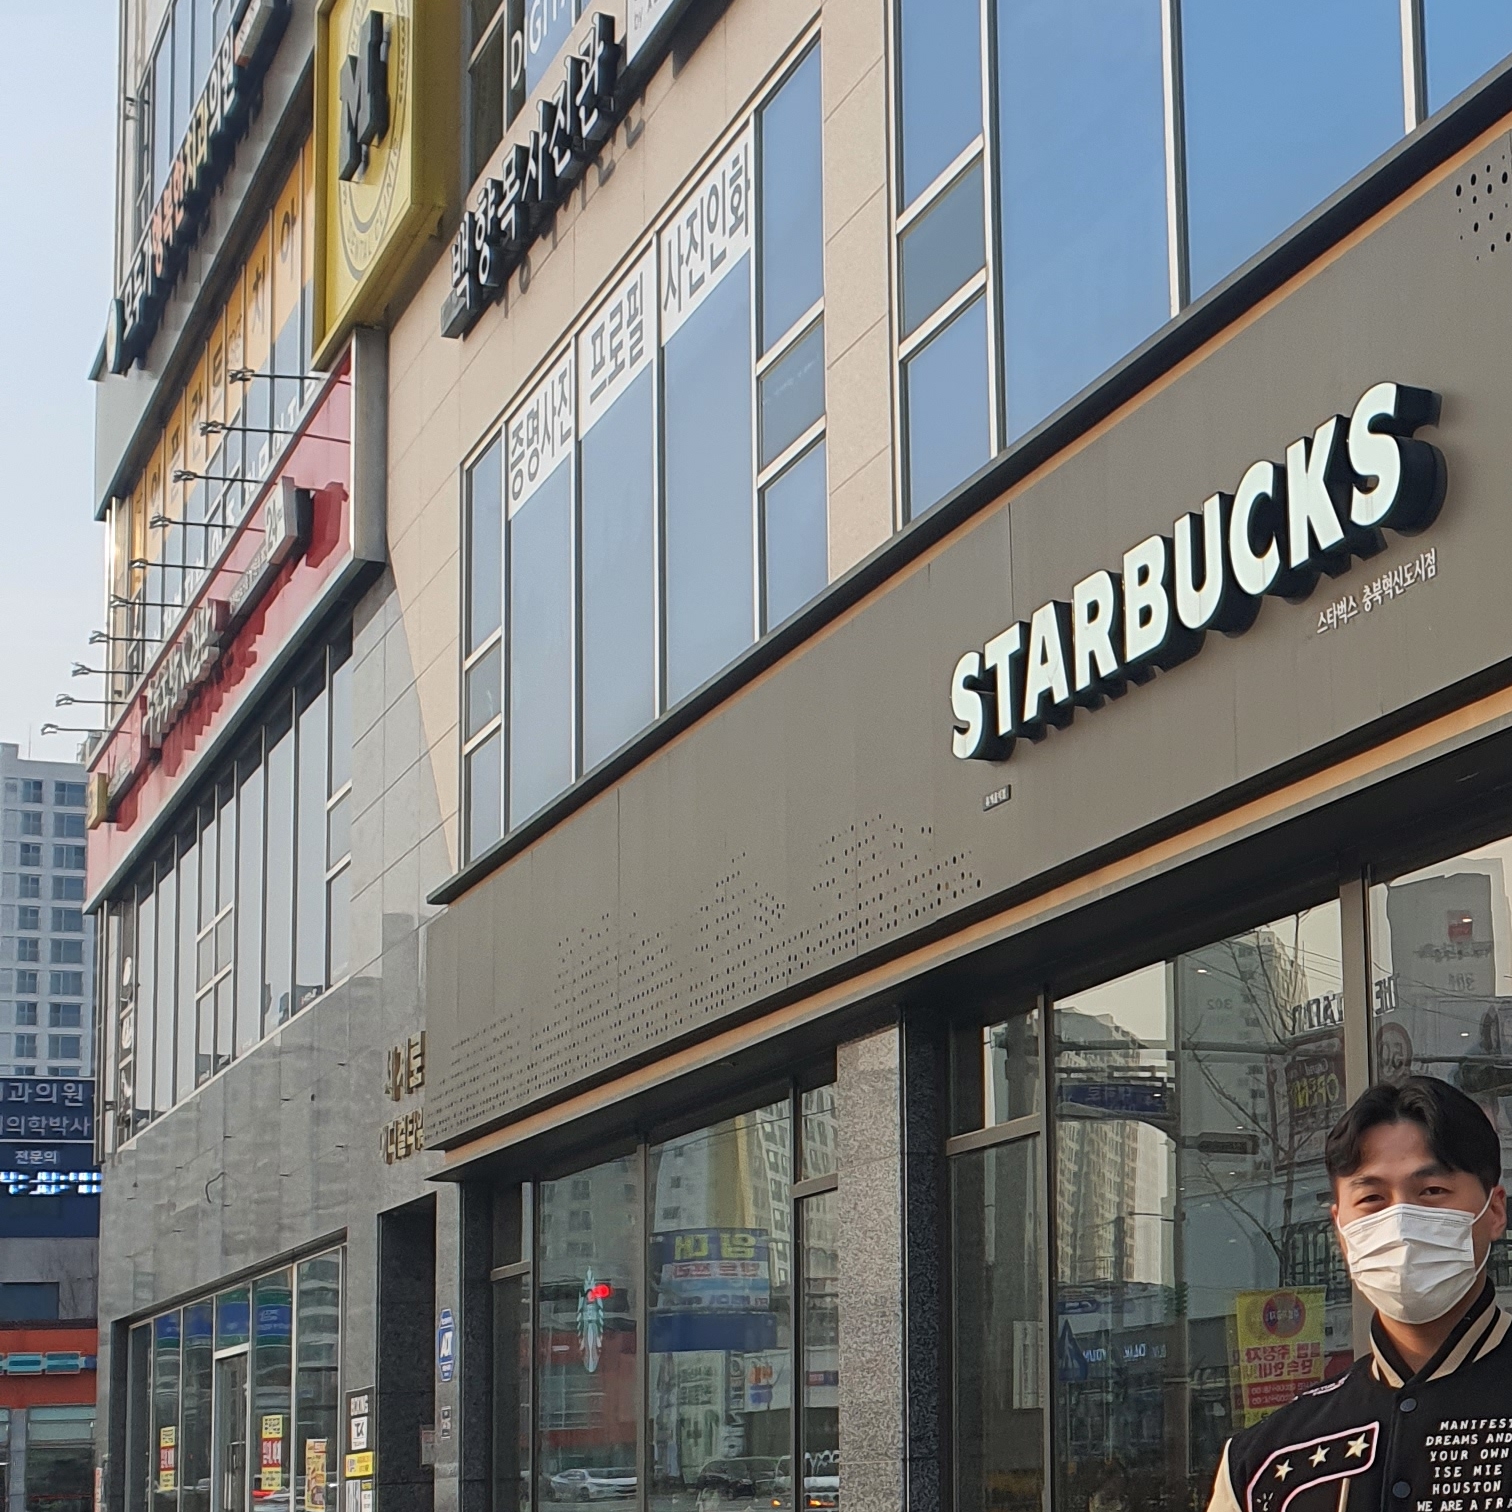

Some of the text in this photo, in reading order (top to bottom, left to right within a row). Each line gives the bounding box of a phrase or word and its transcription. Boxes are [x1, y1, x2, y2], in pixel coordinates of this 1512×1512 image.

[451, 11, 605, 310] 백향목사진관
[663, 141, 751, 313] 사진인화
[589, 271, 644, 405] 프로필
[511, 359, 572, 502] 증명사진
[950, 381, 1402, 761] STARBUCKS
[1316, 547, 1437, 634] 스타벅스 충북혁신도시점
[15, 1150, 58, 1165] 전문의
[1425, 1433, 1479, 1446] DREAMS
[1485, 1432, 1512, 1444] AND
[1429, 1450, 1469, 1462] YOUR
[1480, 1447, 1510, 1460] OWN
[1432, 1480, 1502, 1495] HOUSTON
[1433, 1466, 1462, 1478] ISE
[1473, 1464, 1503, 1477] MIE
[1416, 1501, 1433, 1512] WE
[1439, 1499, 1464, 1512] ARE
[1469, 1499, 1479, 1511] A
